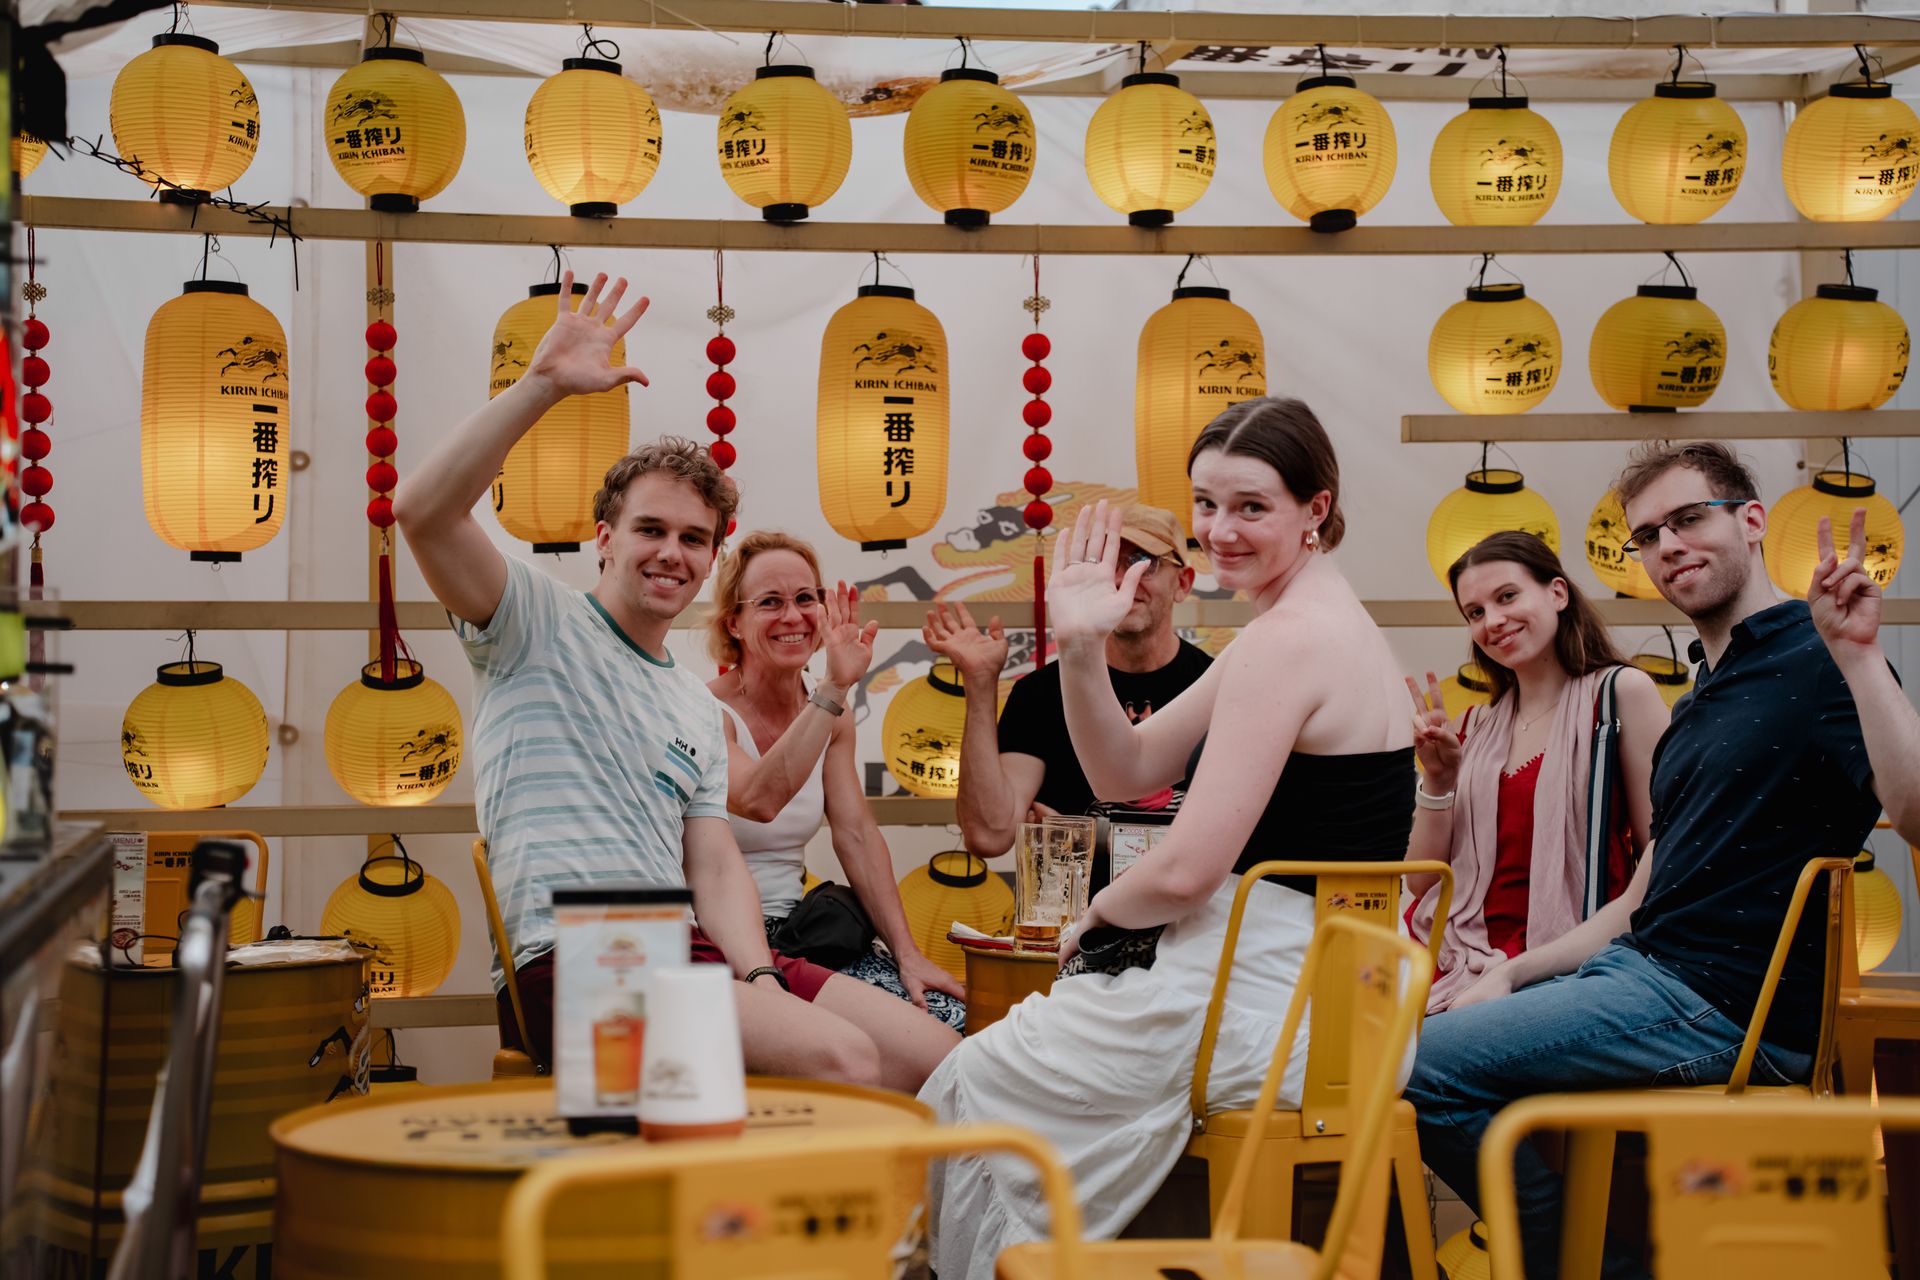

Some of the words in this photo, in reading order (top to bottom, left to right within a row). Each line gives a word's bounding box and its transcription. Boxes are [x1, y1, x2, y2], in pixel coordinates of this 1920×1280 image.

[232, 119, 260, 140] 一番
[228, 134, 250, 149] KIRIN
[334, 126, 401, 149] 一番搾り
[1295, 131, 1367, 151] 一番搾り
[338, 151, 360, 160] KIRIN
[361, 146, 405, 159] ICHIBAN
[972, 139, 1032, 163] 一番搾り
[1295, 153, 1323, 164] KIRIN
[1326, 149, 1368, 163] ICHIBAN
[734, 157, 770, 169] ICHIBAN
[969, 157, 999, 169] KIRIN
[1175, 161, 1199, 173] KIRIN
[1685, 166, 1743, 187] 一番搾り
[1857, 164, 1919, 186] 一番搾り
[1476, 173, 1548, 193] 一番搾り
[1475, 194, 1504, 203] KIRIN
[1508, 192, 1546, 203] ICHIBAN
[1680, 187, 1709, 196] KIRIN
[1854, 188, 1884, 197] KIRIN
[1485, 365, 1554, 388] 一番搾り
[1660, 365, 1722, 385] 一番搾り
[220, 384, 258, 397] KIRIN
[854, 379, 890, 390] KIRIN
[894, 379, 938, 393] ICHIBAN
[1197, 385, 1233, 396] KIRIN
[1484, 388, 1514, 396] KIRIN
[1656, 383, 1687, 393] KIRIN
[883, 396, 915, 508] 一番搾り
[252, 403, 279, 524] 一番搾り
[1587, 541, 1624, 563] 番搾り
[399, 753, 459, 781] 一番搾り
[396, 780, 426, 791] KIRIN
[1354, 899, 1388, 911] 一番搾り
